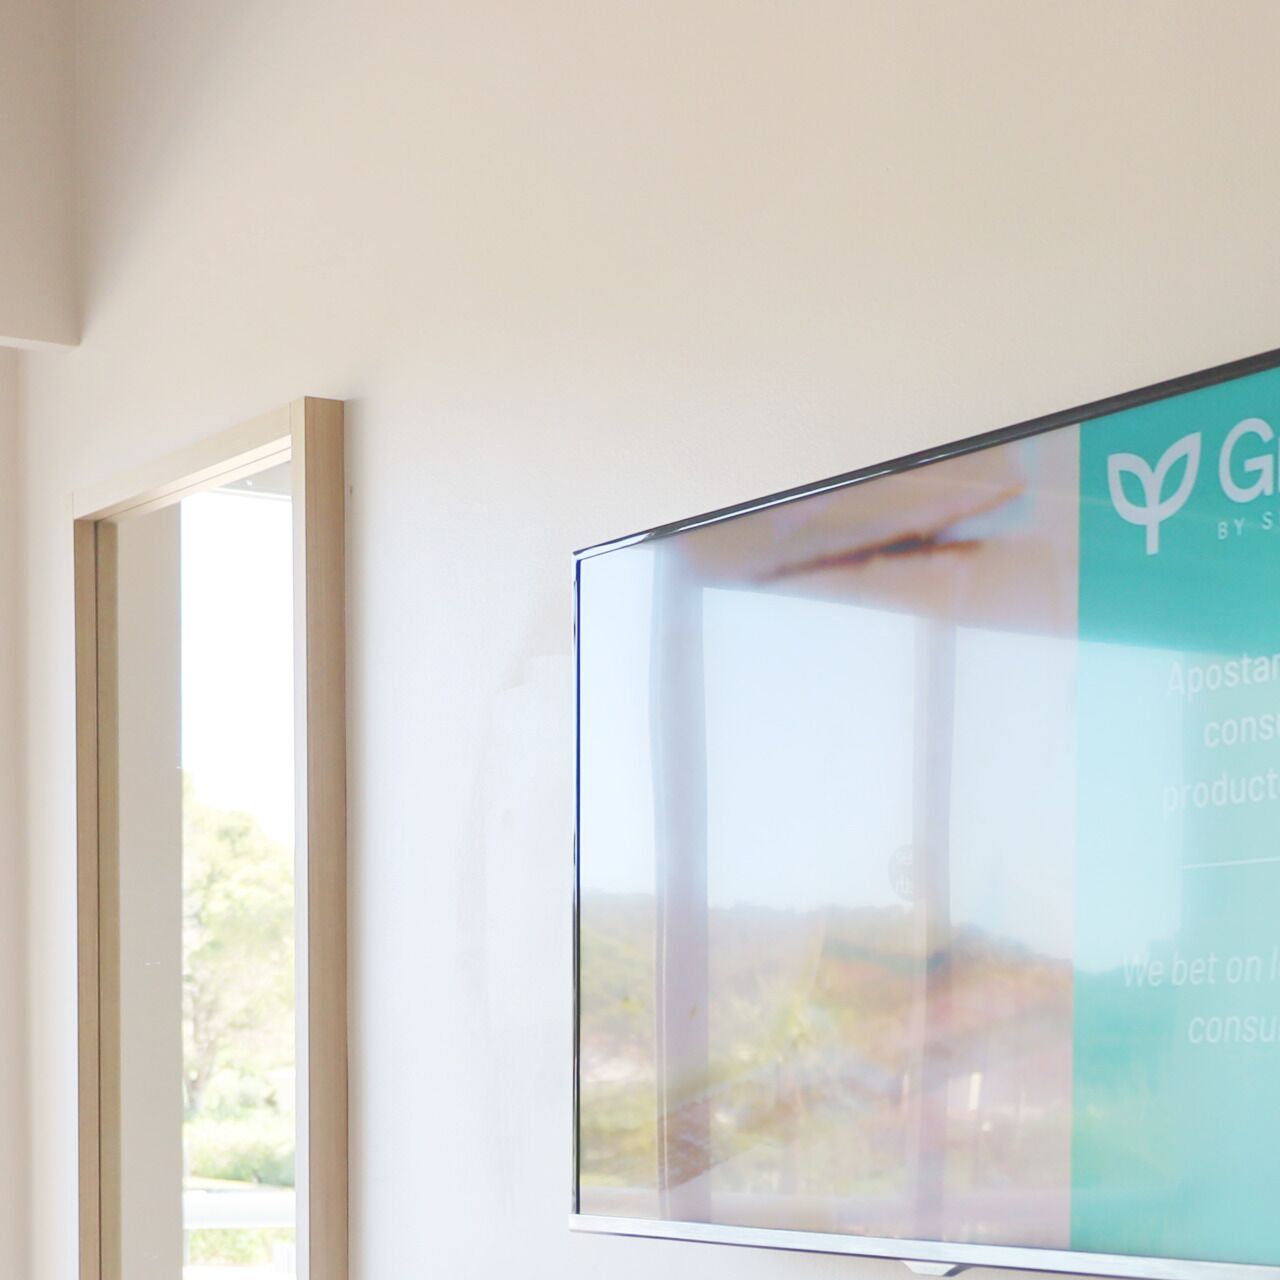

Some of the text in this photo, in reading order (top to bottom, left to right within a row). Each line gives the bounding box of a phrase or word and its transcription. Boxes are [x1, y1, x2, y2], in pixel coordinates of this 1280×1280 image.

[1217, 517, 1245, 540] BY
[1121, 952, 1163, 987] We
[1171, 950, 1218, 986] bet
[1225, 953, 1263, 983] on
